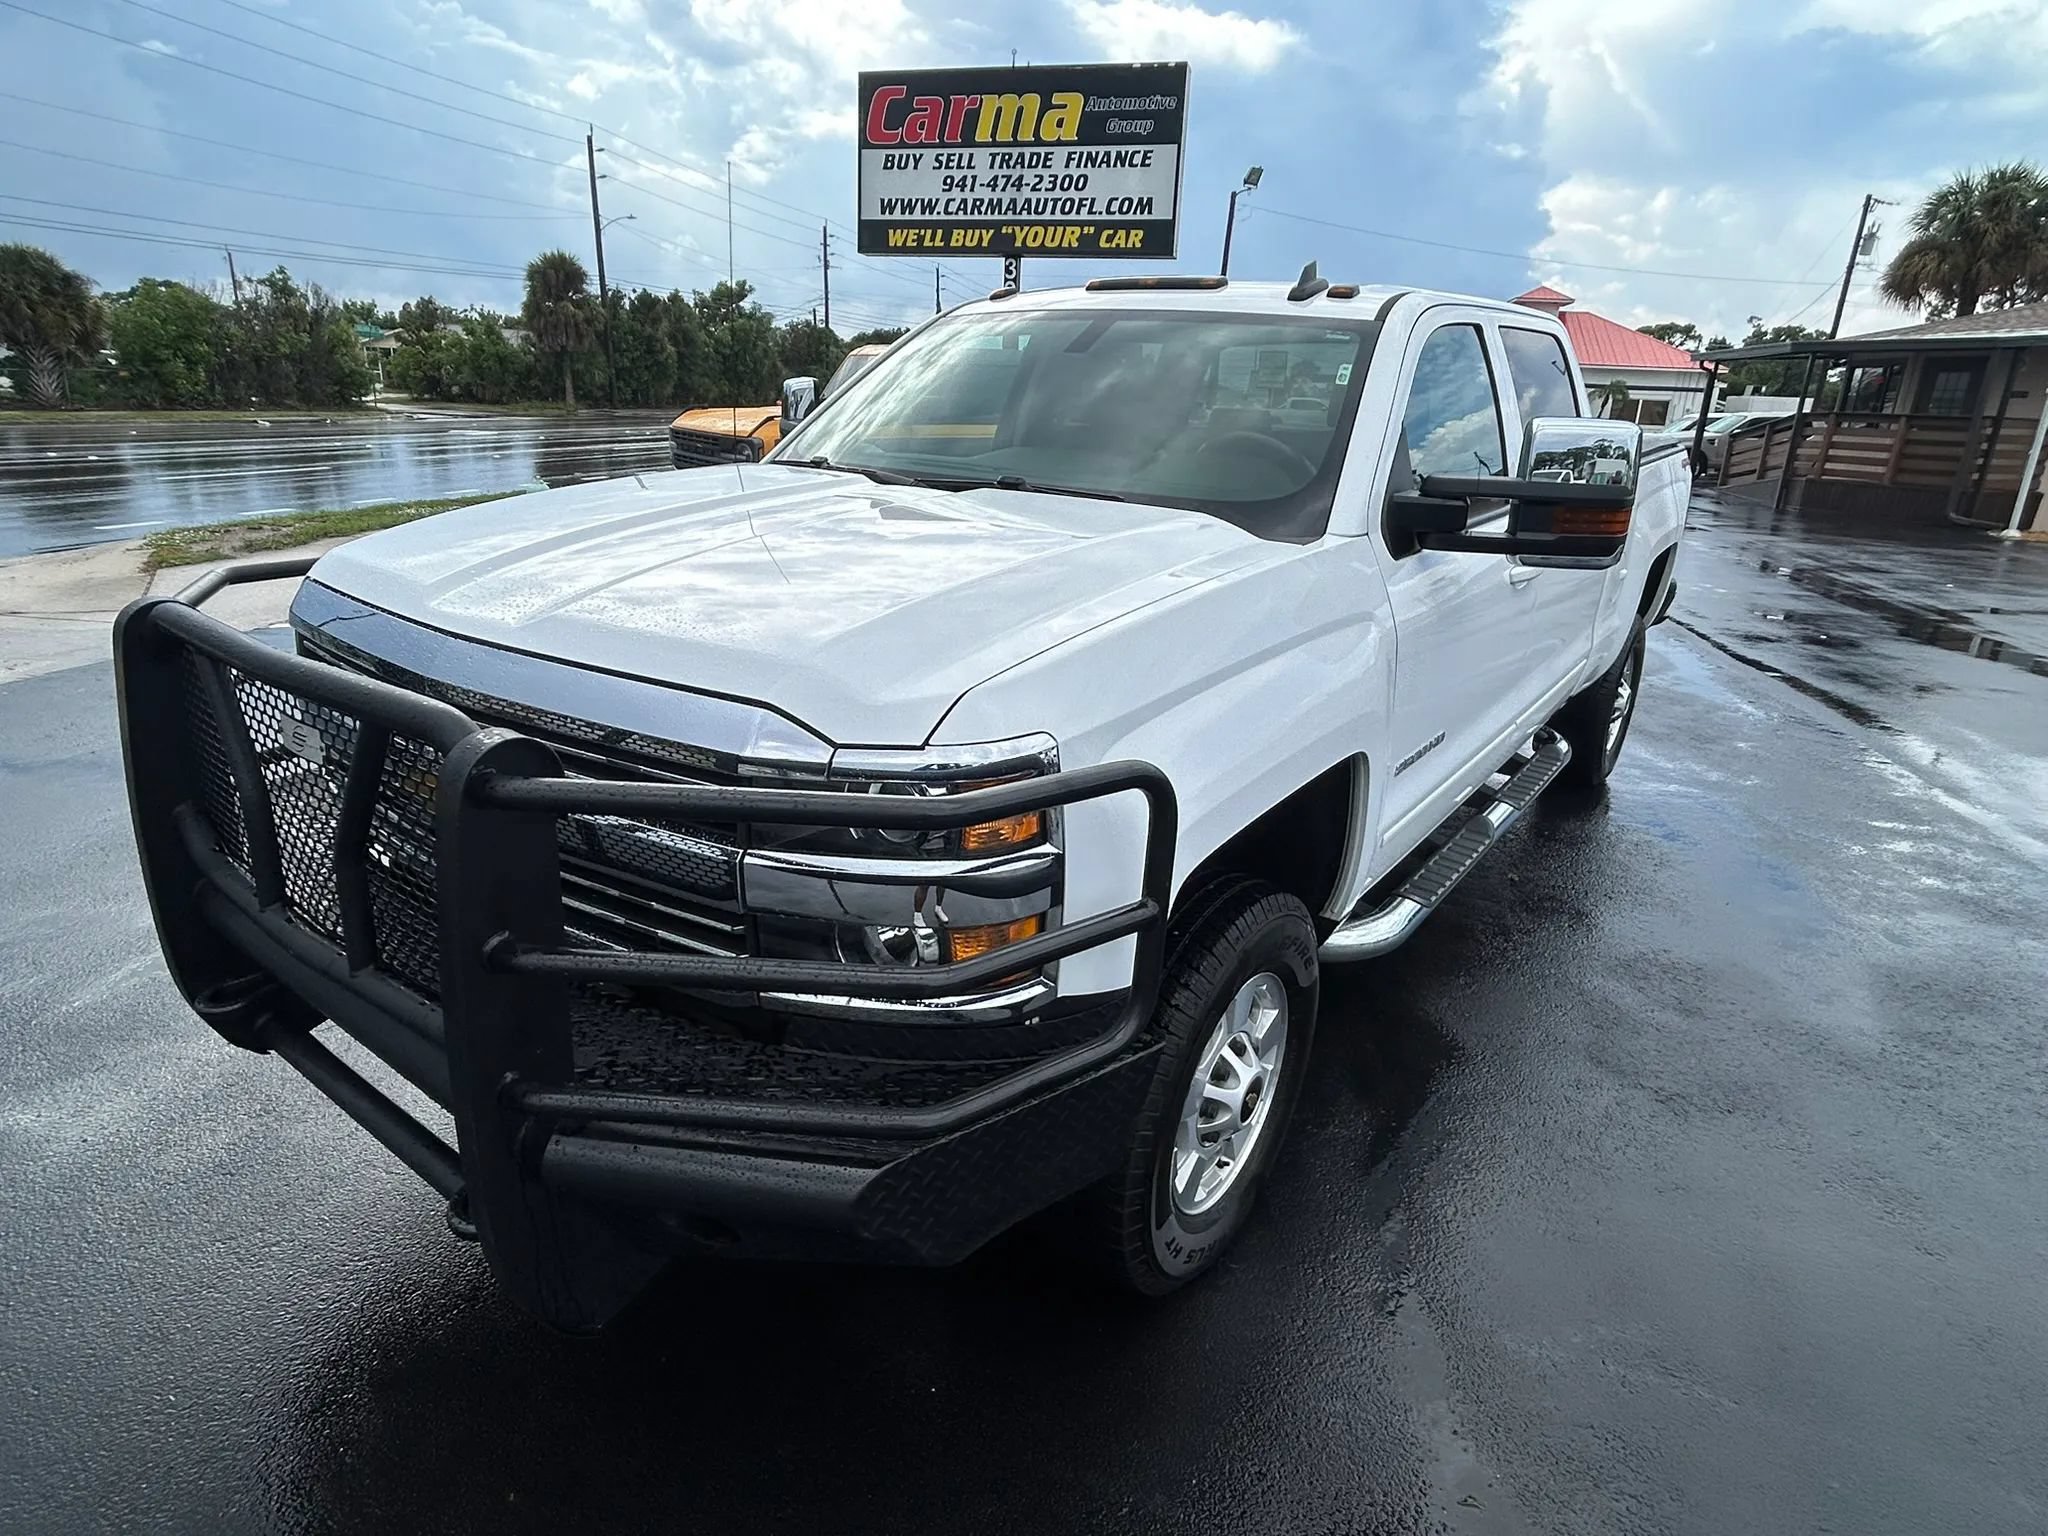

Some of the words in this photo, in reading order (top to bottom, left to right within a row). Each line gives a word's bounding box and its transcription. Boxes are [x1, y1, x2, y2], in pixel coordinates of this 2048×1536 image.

[1085, 95, 1178, 112] Automotive
[866, 85, 1085, 145] Carma
[1105, 118, 1154, 135] Group
[882, 152, 924, 171] BUY
[932, 152, 976, 170] SELL
[988, 151, 1054, 170] TRADE
[1064, 150, 1154, 169] FINANCE
[941, 174, 1089, 193] 941-474-2300
[879, 197, 1154, 217] WWW.CARMAAUTOFL.COM
[887, 229, 944, 248] WE'LL
[950, 228, 994, 248] BUY
[1099, 228, 1144, 248] CAR
